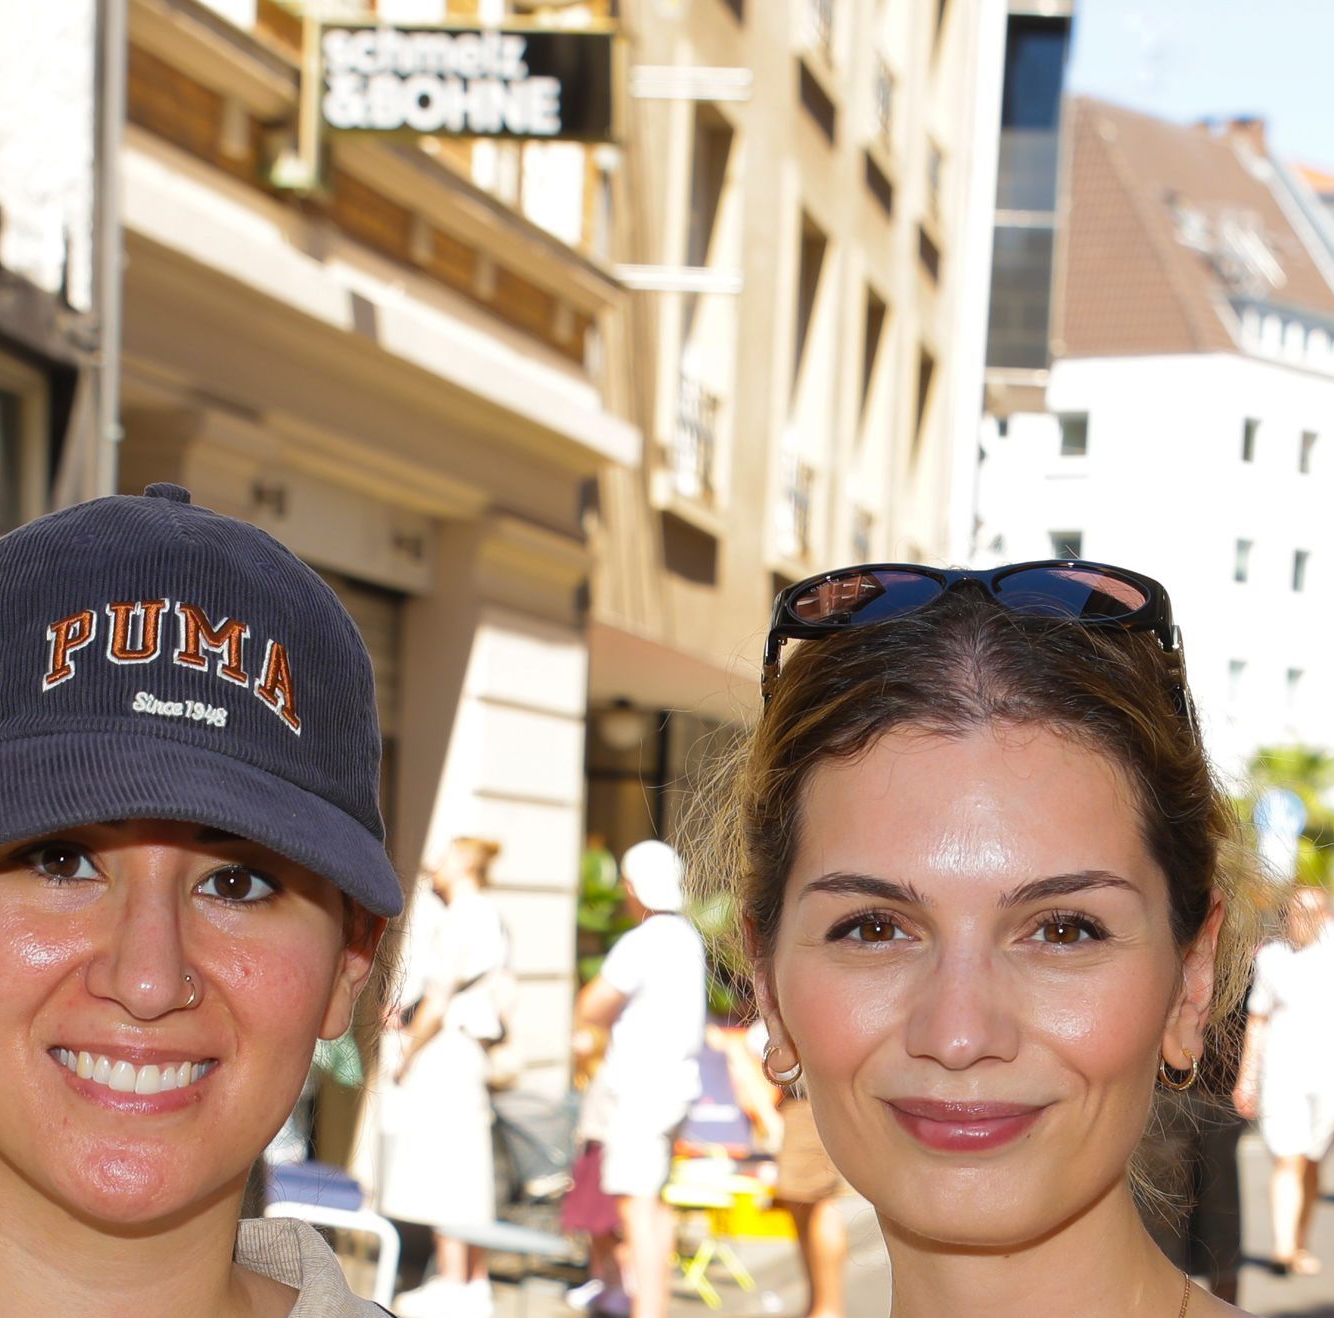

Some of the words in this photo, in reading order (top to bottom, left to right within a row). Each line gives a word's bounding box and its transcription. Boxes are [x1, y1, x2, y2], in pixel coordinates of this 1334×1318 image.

[42, 597, 301, 736] PUMA
[132, 691, 184, 716] Since
[184, 700, 228, 728] 1948
